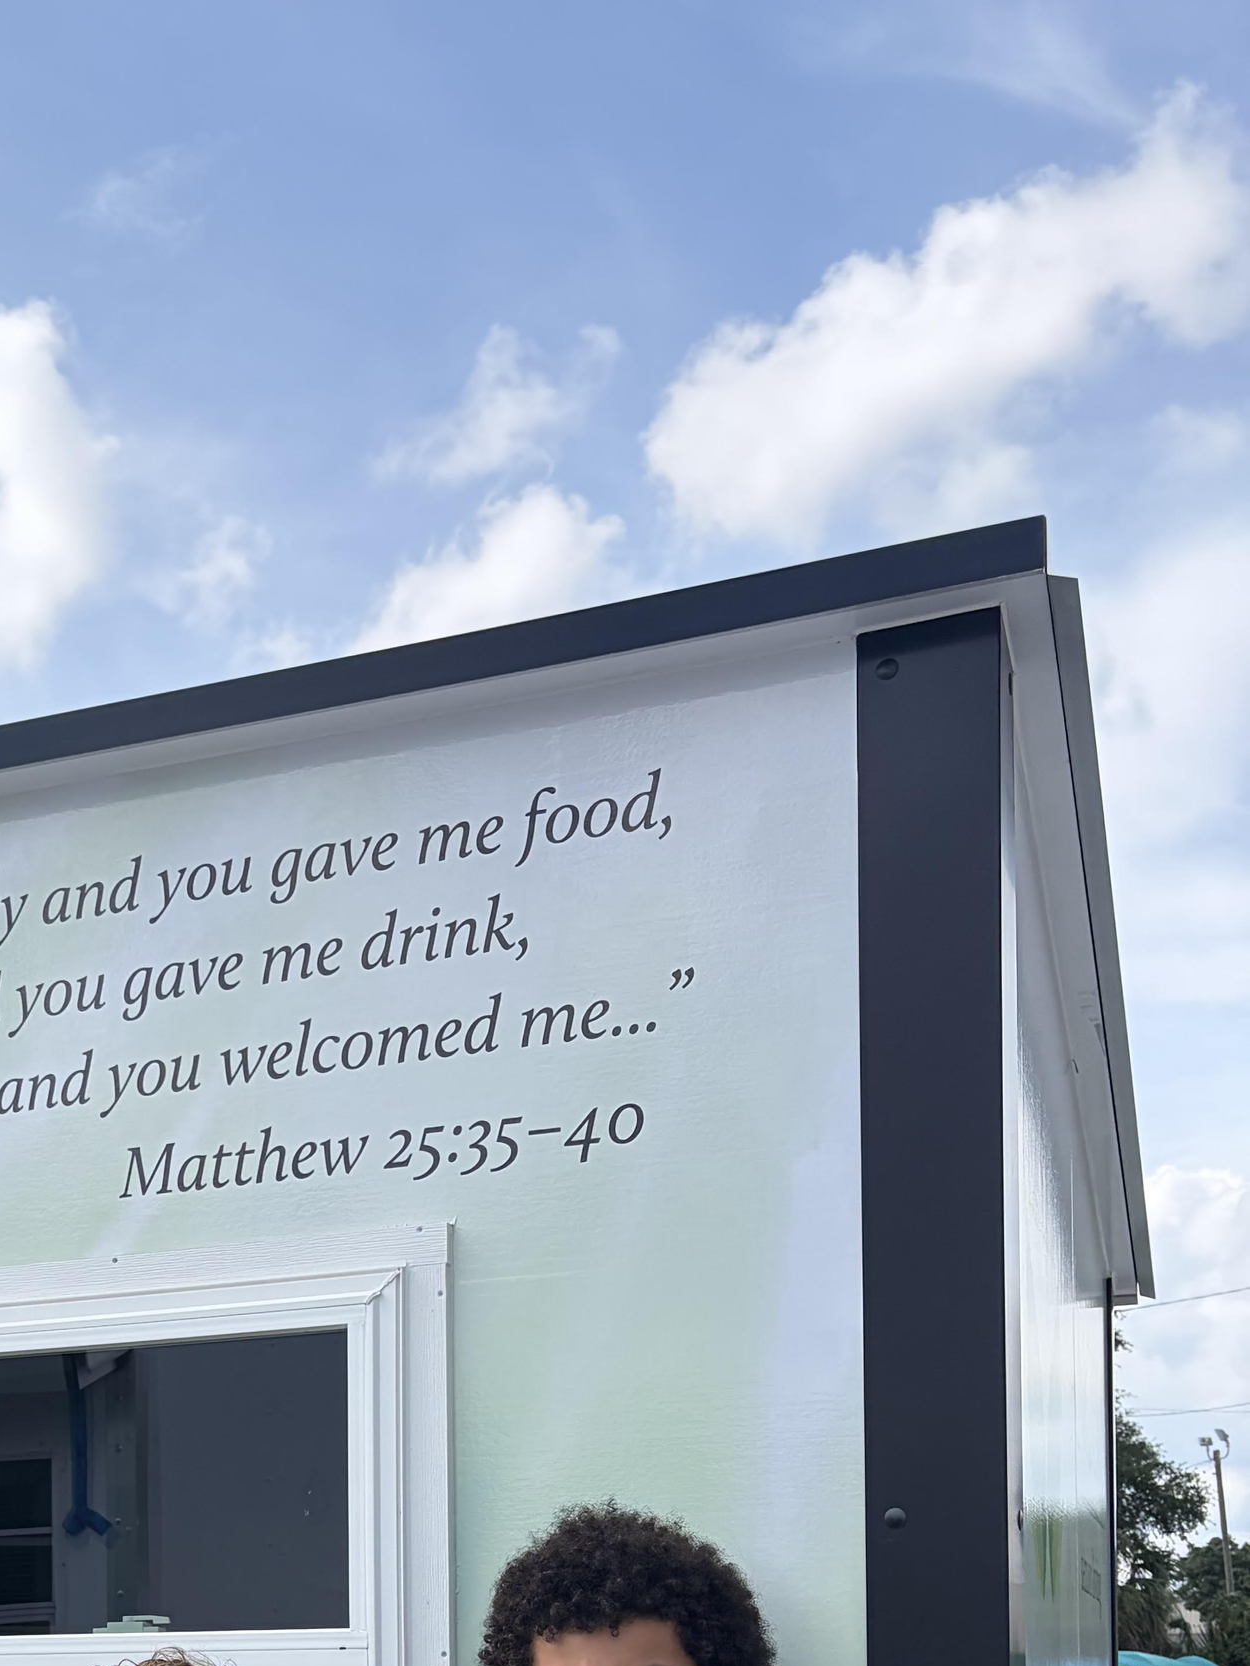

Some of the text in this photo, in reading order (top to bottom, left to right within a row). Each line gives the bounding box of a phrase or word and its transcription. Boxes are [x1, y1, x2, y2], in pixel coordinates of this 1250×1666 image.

[42, 854, 143, 925] and
[148, 856, 253, 925] you
[269, 832, 399, 905] gave
[418, 815, 504, 865] me
[514, 767, 672, 868] food,
[7, 973, 106, 1039] you
[122, 952, 244, 1022] gave
[261, 937, 343, 985] me
[360, 892, 529, 971] drink,
[99, 1053, 201, 1119] you
[219, 991, 503, 1086] welcomed
[118, 1125, 370, 1199] Matthew
